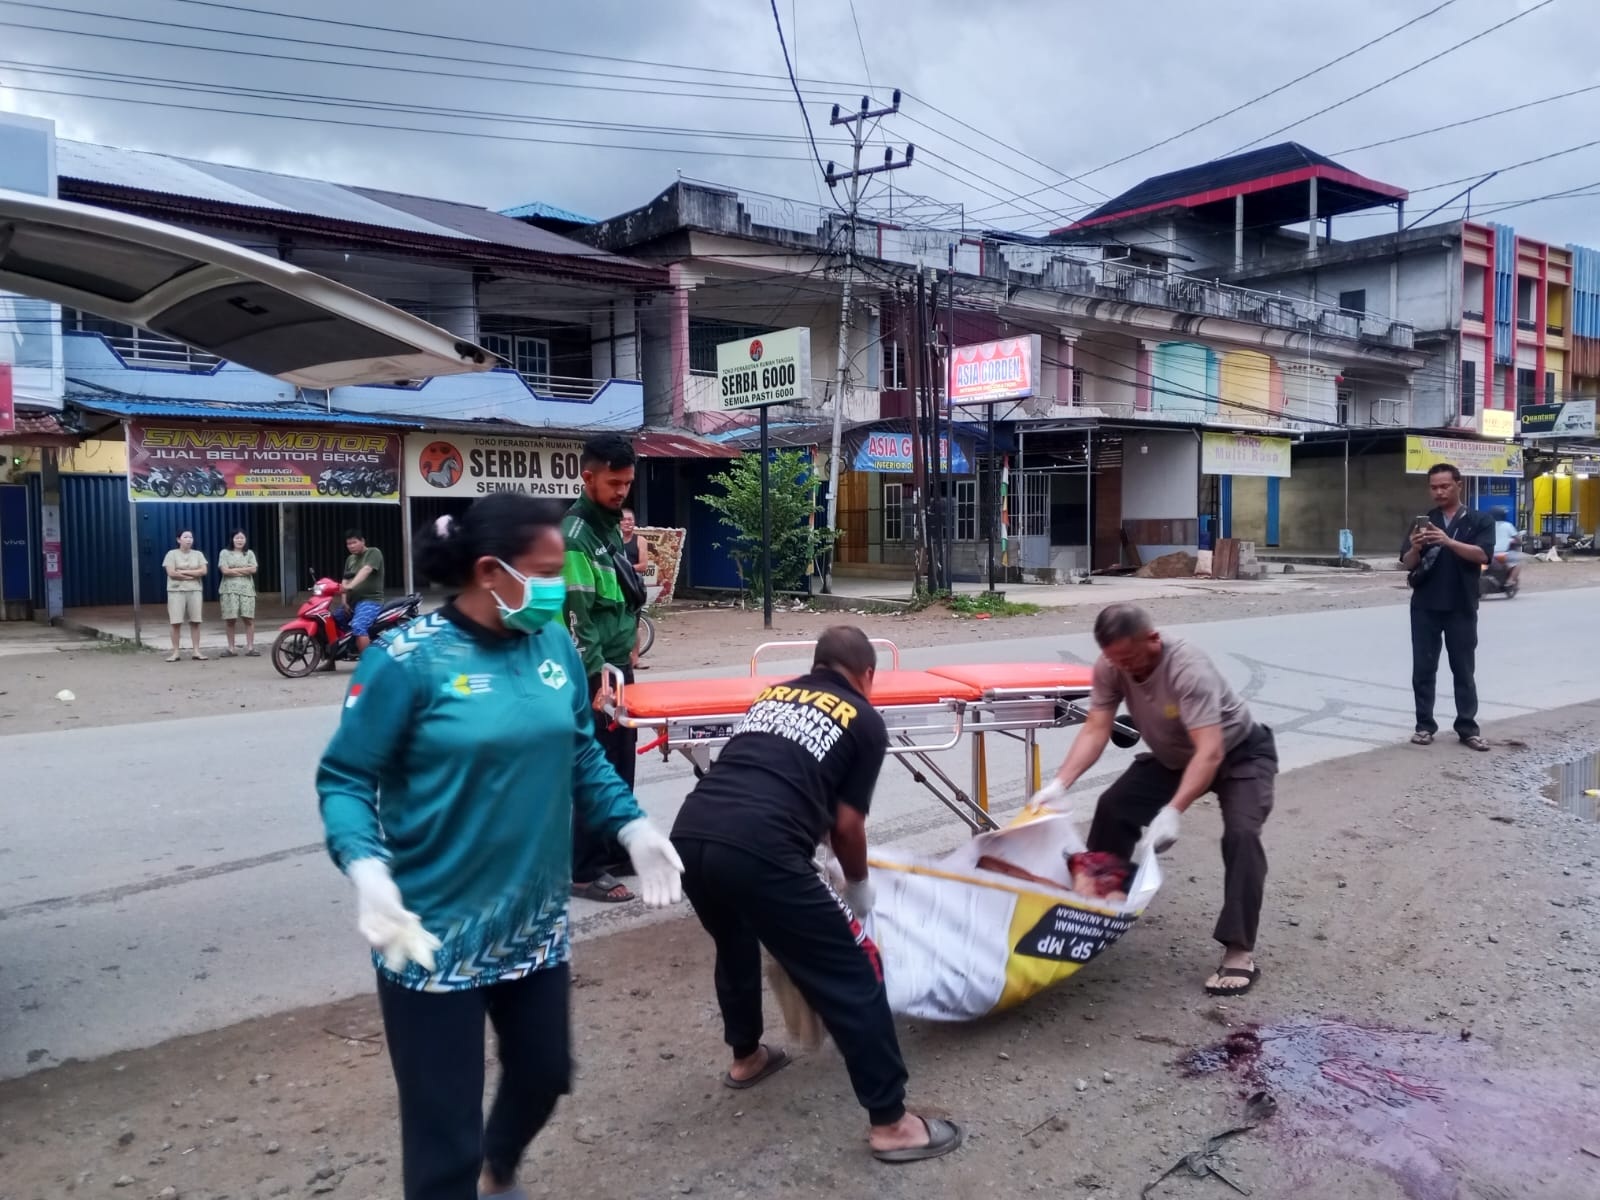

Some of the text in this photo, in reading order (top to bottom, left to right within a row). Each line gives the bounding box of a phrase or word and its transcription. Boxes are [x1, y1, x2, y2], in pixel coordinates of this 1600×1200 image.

[722, 356, 795, 376] TOKO PERABOTAN RUMAH TANGGA
[958, 356, 1020, 386] ASIA GORDEN
[721, 363, 796, 397] SERBA 6000
[724, 387, 794, 407] SEMUA PASTI 6000
[1521, 413, 1557, 425] Quantum
[142, 428, 388, 454] SINAR MOTOR
[475, 438, 496, 446] TOKO
[500, 439, 544, 448] PERABOTAN
[868, 437, 898, 457] ASIA
[1236, 437, 1261, 448] TOKO
[150, 449, 380, 463] JUAL BELI MOTOR BEKAS
[1215, 447, 1246, 461] Multi
[469, 449, 584, 480] SERBA 60
[476, 481, 527, 495] SEMUA
[530, 483, 569, 495] PASTI
[755, 685, 858, 729] DRIVER
[744, 709, 835, 752] USKESMAS
[774, 724, 826, 763] PINYUH
[1055, 907, 1103, 926] ANJONGAN
[1054, 919, 1104, 938] MEMPAWAH
[1036, 935, 1066, 956] MP
